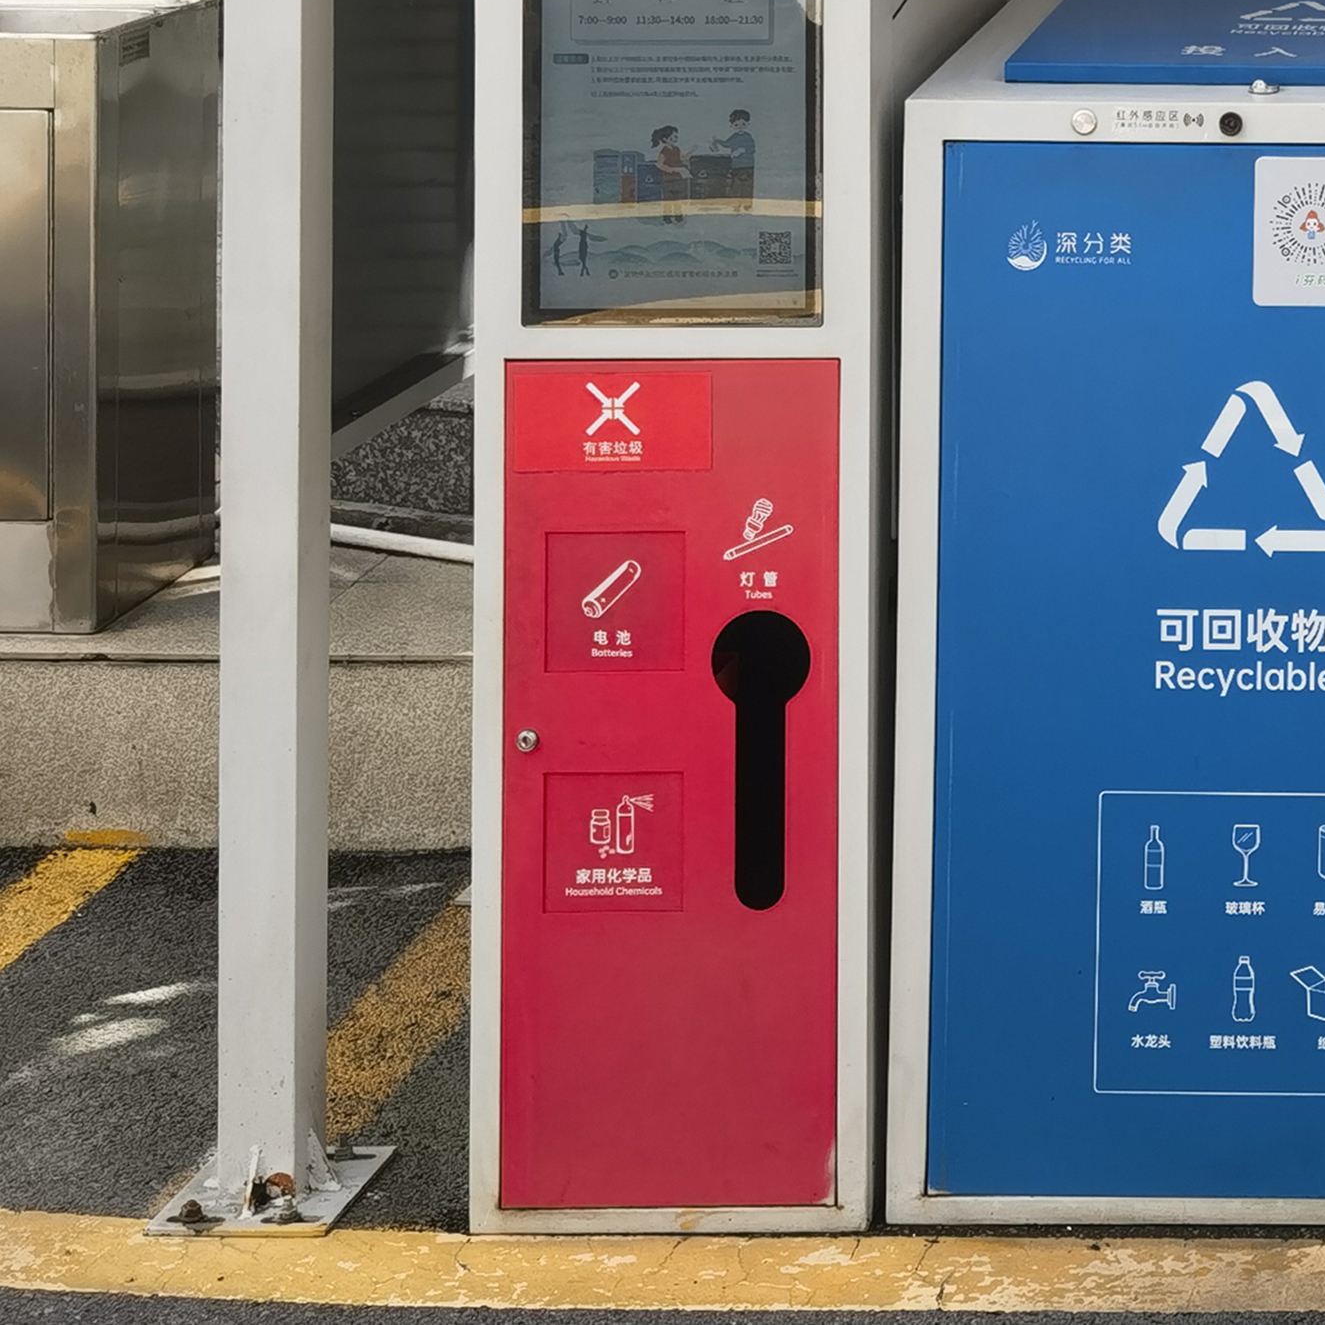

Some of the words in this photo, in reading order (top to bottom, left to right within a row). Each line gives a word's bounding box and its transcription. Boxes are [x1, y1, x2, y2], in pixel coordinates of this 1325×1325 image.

[1114, 107, 1182, 123] 红外感应区
[1056, 233, 1131, 254] 深分类
[1056, 256, 1096, 264] RECYCLING
[583, 441, 643, 455] 有害垃圾
[745, 590, 772, 599] Tubes
[591, 648, 632, 657] Batteries
[576, 868, 652, 884] 家用化学品
[564, 887, 612, 897] Household
[617, 887, 663, 898] Chemicals
[1140, 901, 1167, 914] 酒瓶
[1226, 901, 1265, 915] 玻璃杯
[1131, 1034, 1170, 1048] 水龙头
[1210, 1035, 1276, 1049] 塑料饮料瓶
